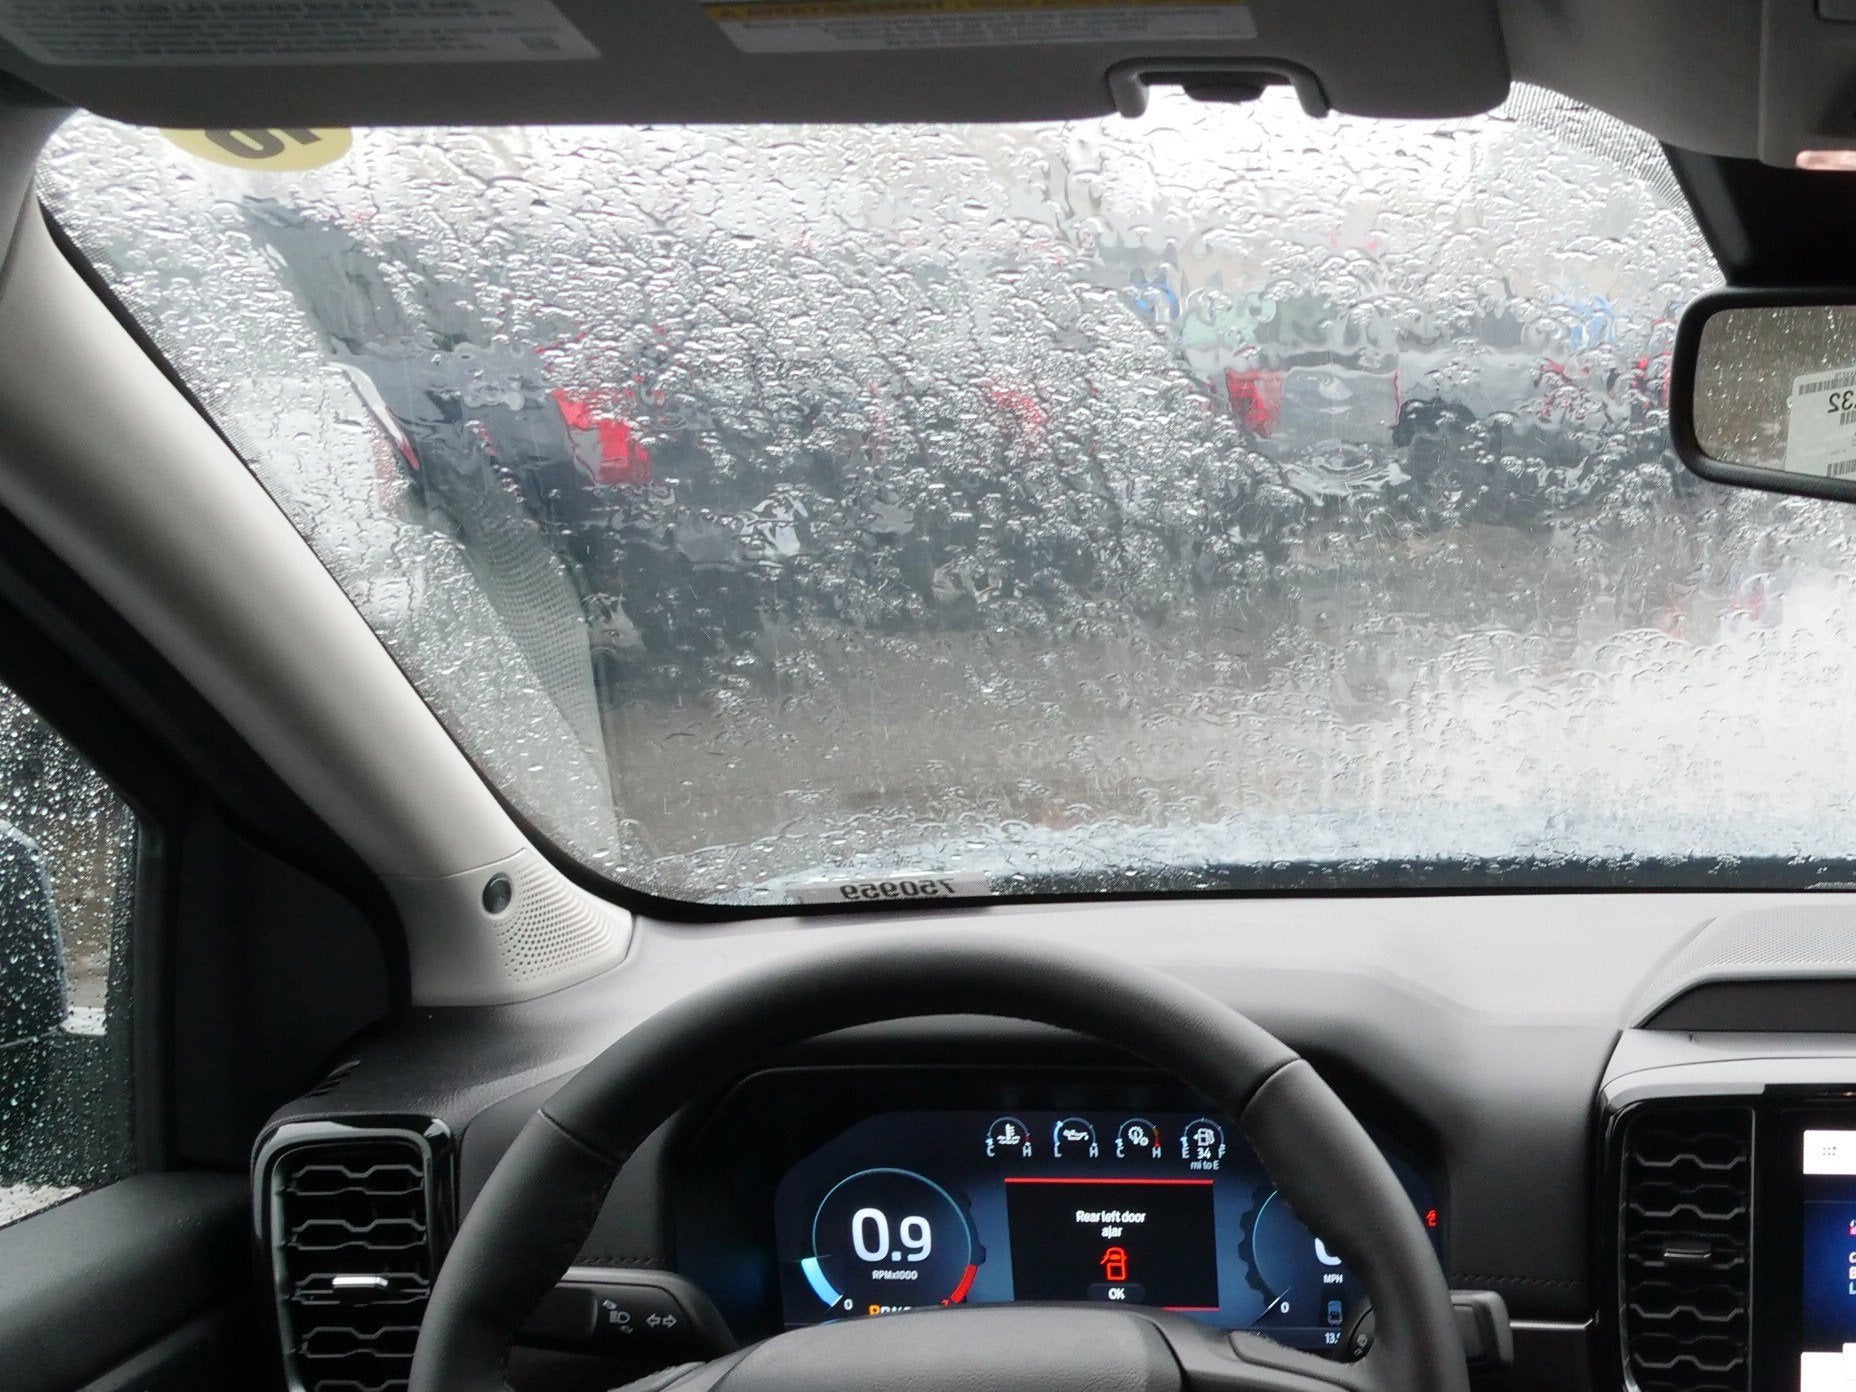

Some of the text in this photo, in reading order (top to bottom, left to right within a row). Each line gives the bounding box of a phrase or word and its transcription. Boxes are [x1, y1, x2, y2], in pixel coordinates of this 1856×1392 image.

[1022, 1145, 1032, 1157] H
[1055, 1145, 1062, 1157] L
[1152, 1146, 1161, 1158] H
[1182, 1149, 1190, 1159] E
[1197, 1148, 1211, 1159] 34
[1218, 1149, 1226, 1159] F
[1190, 1161, 1220, 1170] mi to E
[1075, 1210, 1147, 1223] Rear left door
[852, 1207, 932, 1262] 0.9
[1101, 1225, 1123, 1239] ajar
[1323, 1274, 1344, 1284] MPH
[1108, 1287, 1126, 1300] OK
[844, 1298, 853, 1311] 0
[1280, 1301, 1290, 1314] 0
